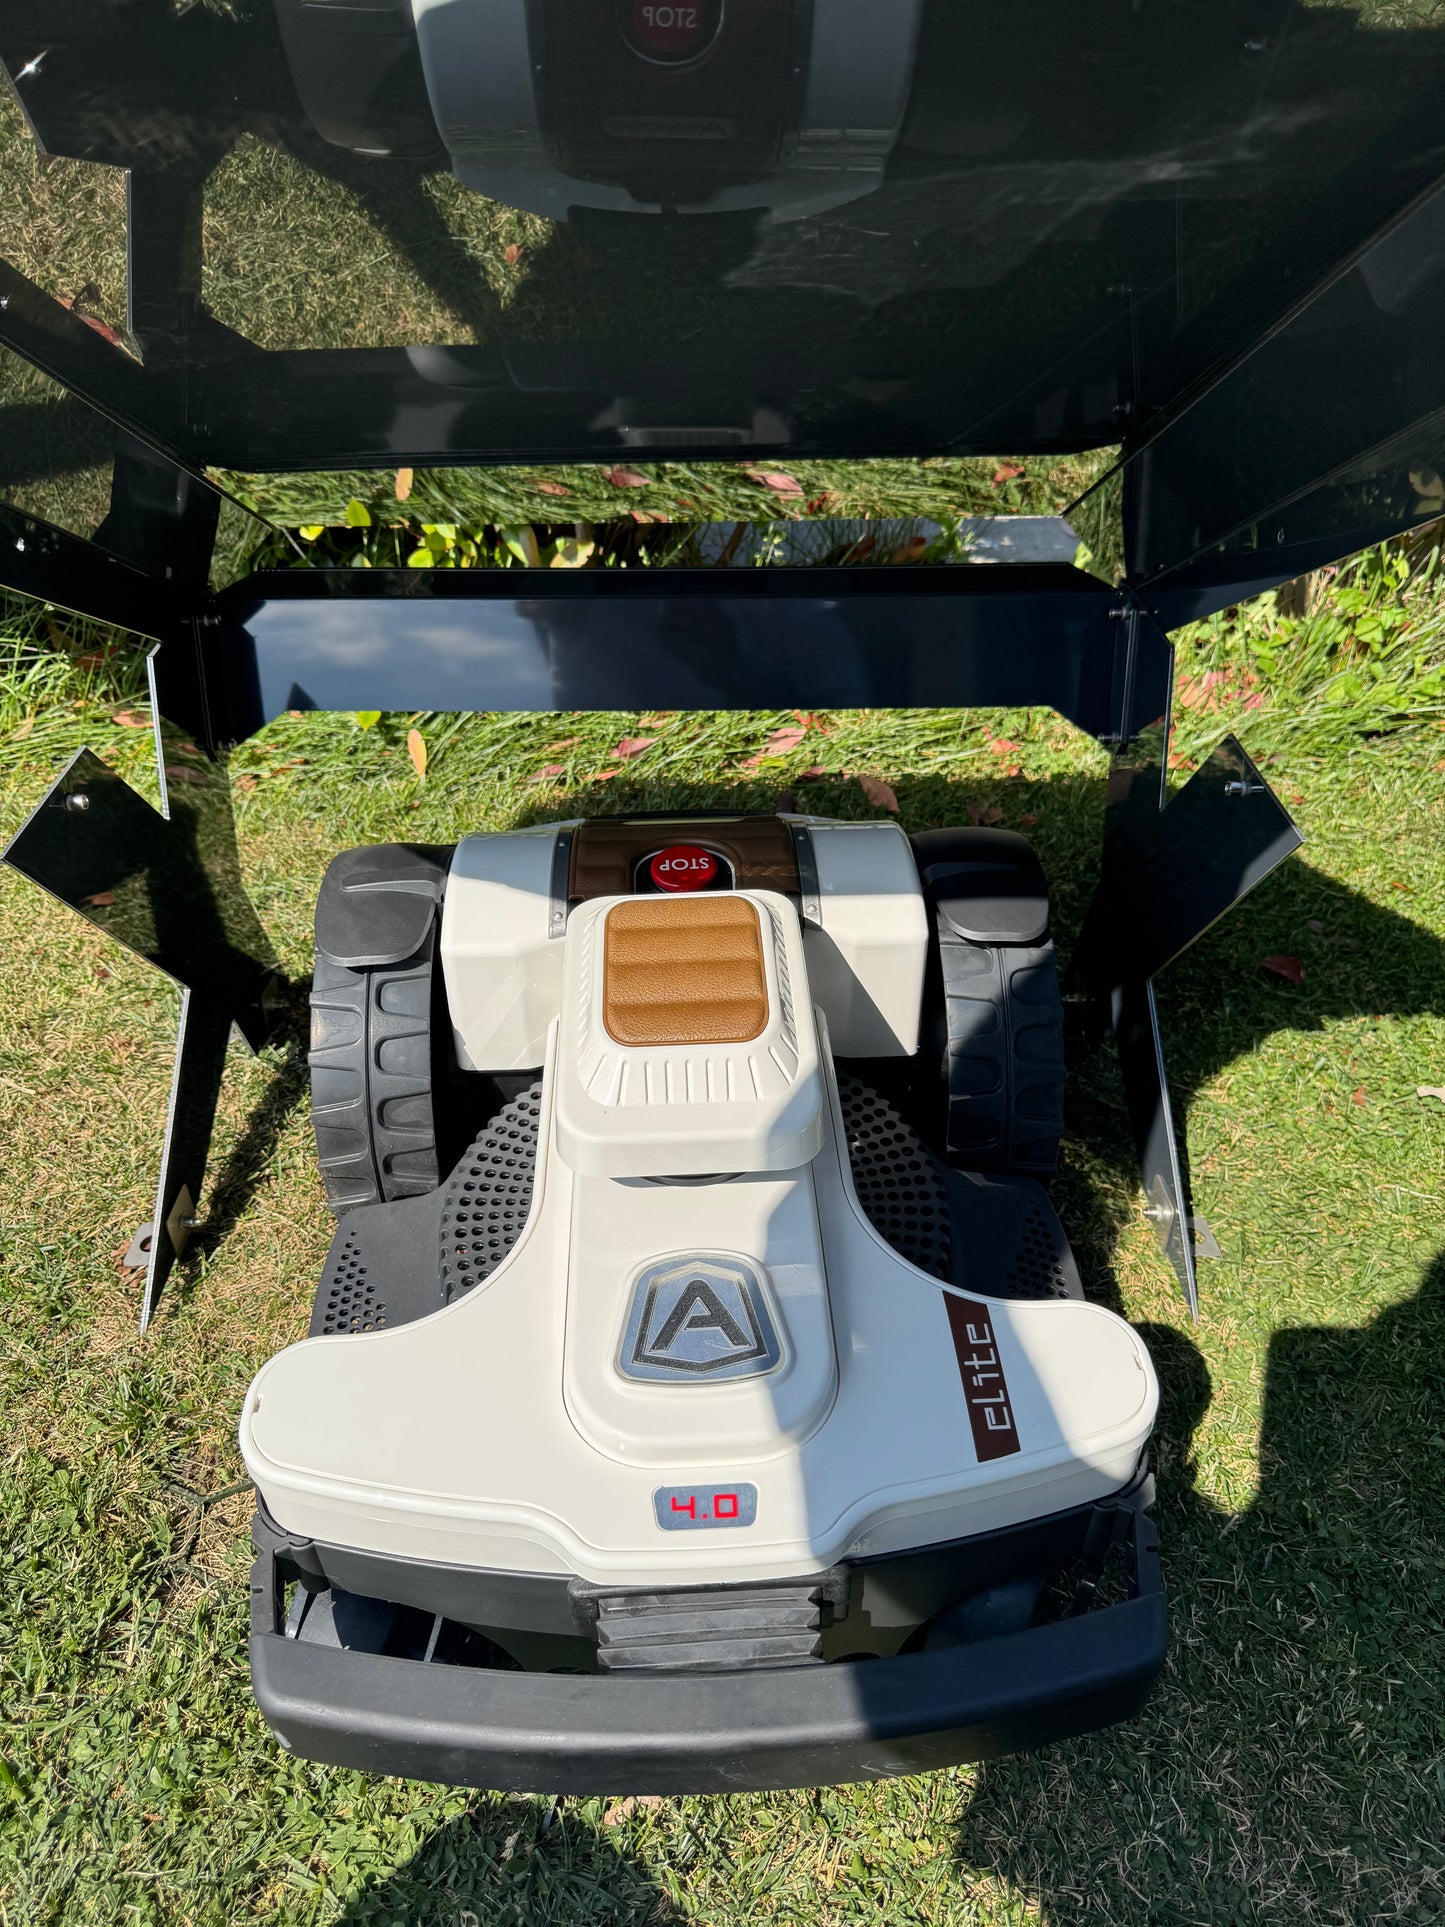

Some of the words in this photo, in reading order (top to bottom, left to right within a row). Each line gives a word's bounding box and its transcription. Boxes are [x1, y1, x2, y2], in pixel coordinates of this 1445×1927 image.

[659, 857, 710, 871] STOP
[649, 1278, 753, 1352] A
[670, 1493, 739, 1520] 4.0
